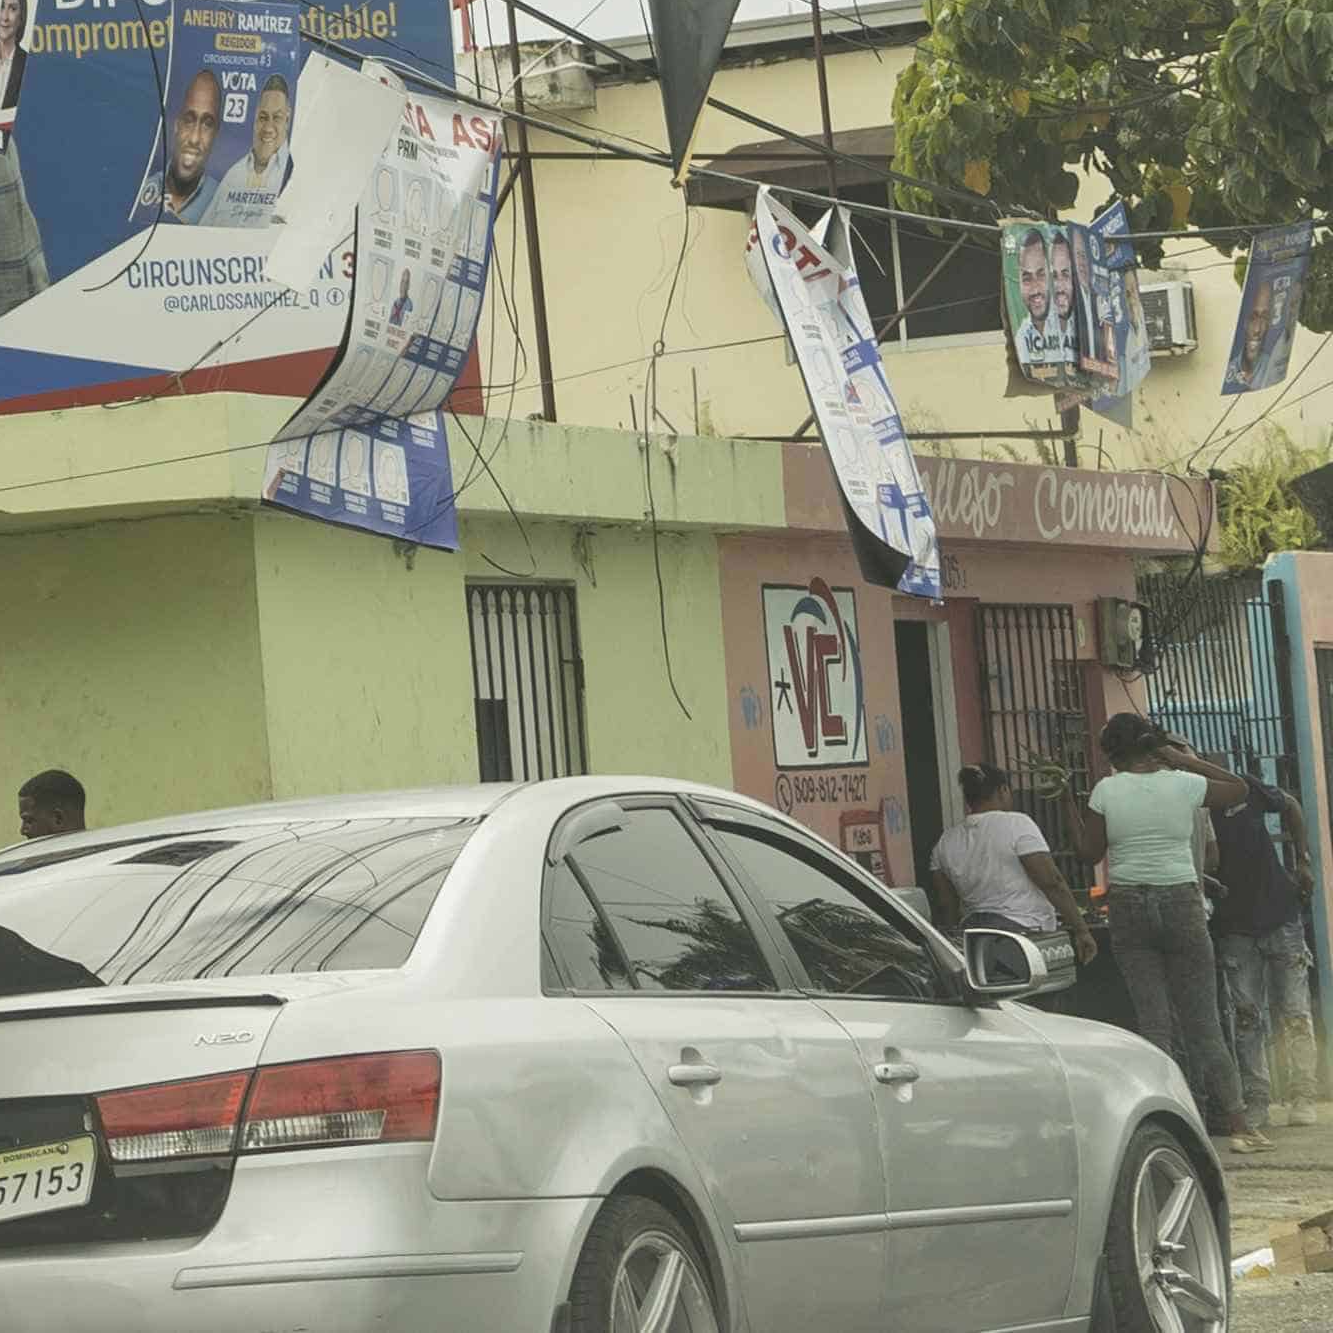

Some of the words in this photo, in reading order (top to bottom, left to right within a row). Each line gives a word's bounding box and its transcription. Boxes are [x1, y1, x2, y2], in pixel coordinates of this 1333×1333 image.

[184, 9, 235, 28] ANEURY
[238, 10, 293, 33] RAMÍREZ
[222, 71, 257, 91] VOTA
[226, 98, 245, 120] 23
[164, 287, 320, 314] @CARLOSSANCHEZ_Q
[794, 774, 867, 804] 809-812-7427
